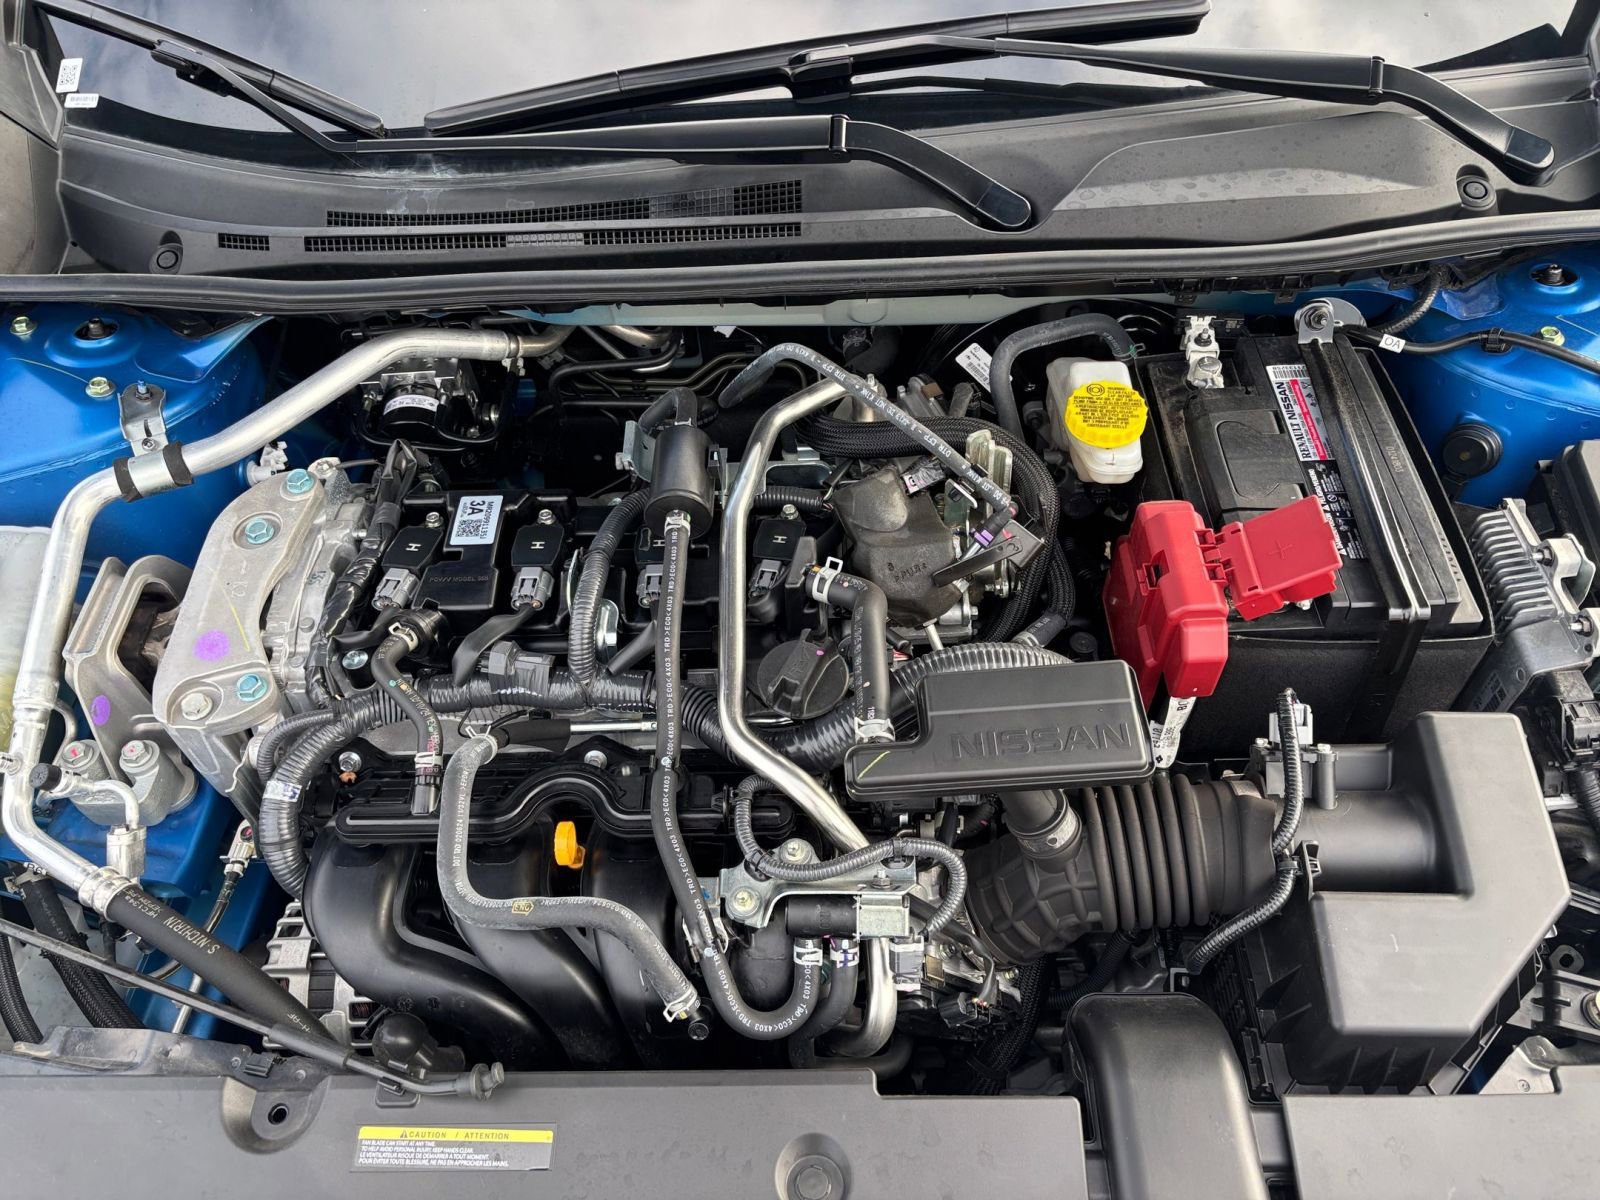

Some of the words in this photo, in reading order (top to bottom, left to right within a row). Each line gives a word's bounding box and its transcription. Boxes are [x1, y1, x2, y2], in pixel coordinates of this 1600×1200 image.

[859, 387, 875, 401] KINK
[874, 397, 887, 409] NOT
[1275, 382, 1295, 419] NISSAN
[937, 443, 952, 458] DTR
[1291, 422, 1311, 459] RENAULT
[467, 500, 485, 516] 3A
[664, 596, 673, 652] TRD>ECO<4X03
[664, 657, 674, 718] TRD>ECO<4X03
[951, 722, 1132, 760] NISSAN
[662, 775, 673, 831] TRD>ECO<4X03
[454, 818, 463, 842] 020624
[718, 969, 751, 1027] TRD>ECO<4X03
[409, 1130, 447, 1139] CAUTION
[464, 1131, 510, 1140] ATTENTION
